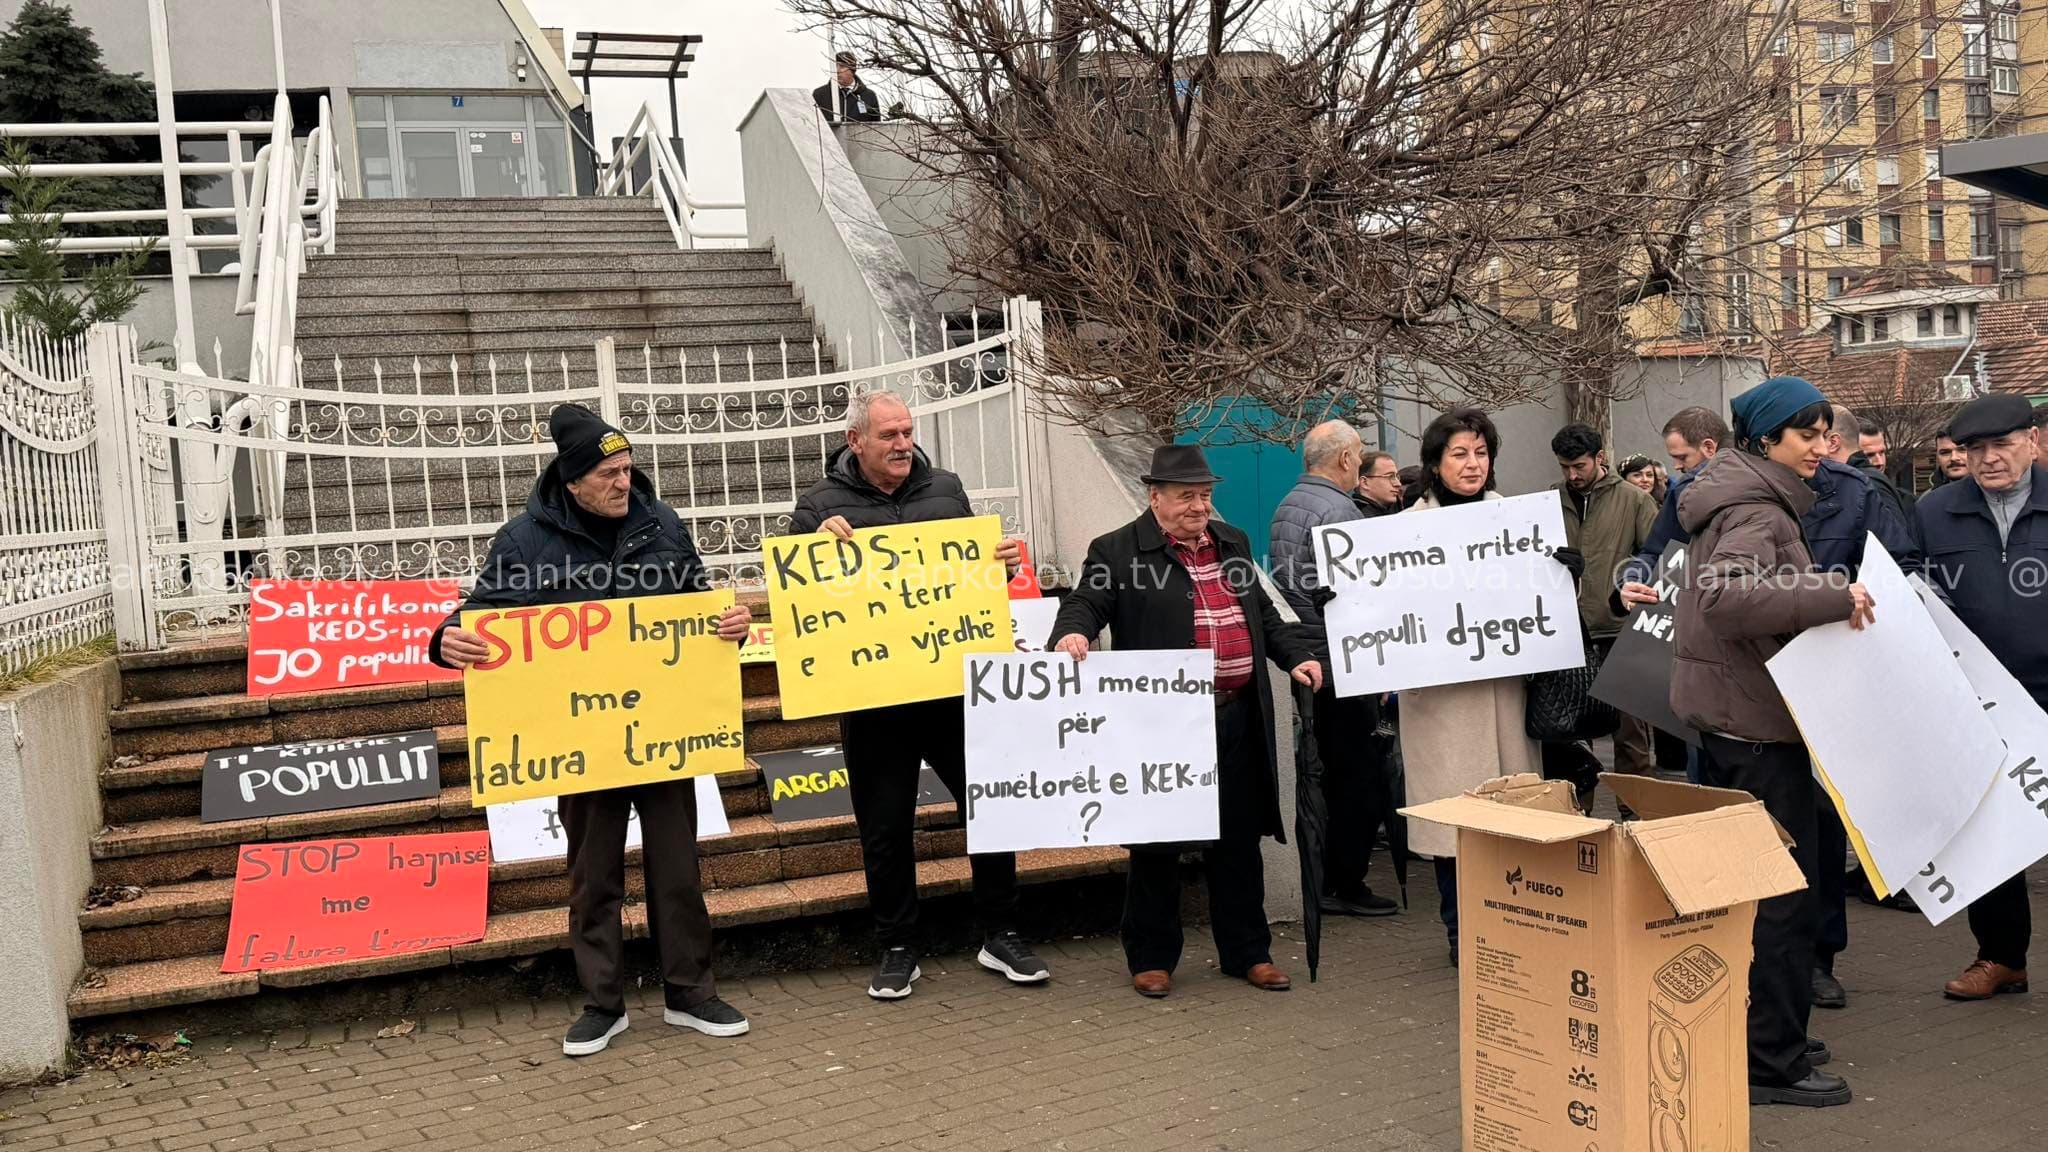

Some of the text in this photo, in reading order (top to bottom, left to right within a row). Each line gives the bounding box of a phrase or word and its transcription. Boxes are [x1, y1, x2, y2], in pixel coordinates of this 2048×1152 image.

[454, 96, 461, 107] 7
[772, 534, 980, 590] KEDS-i na
[1321, 528, 1446, 587] Rryma
[473, 601, 732, 671] STOP hajnis
[791, 603, 846, 639] len
[1341, 595, 1557, 674] populli djeget
[800, 656, 815, 677] e
[851, 642, 890, 667] na
[911, 609, 995, 663] vjedhë
[254, 647, 323, 685] JO
[971, 659, 1215, 707] KUSH mendon
[570, 689, 642, 717] me
[1058, 712, 1107, 749] për
[239, 745, 434, 803] POPULLIT
[473, 733, 586, 794] fatura
[967, 762, 1217, 821] punëtorët e KEK-ut
[1079, 801, 1101, 843] ?
[242, 842, 487, 888] STOP hajnisë
[321, 896, 370, 915] me
[1526, 880, 1564, 898] FUEGO
[1484, 899, 1588, 929] MULTIFUNCTIONAL BT SPEAKER
[239, 934, 347, 968] fatura
[1476, 936, 1486, 944] EN
[1476, 993, 1486, 1001] AL
[1572, 998, 1595, 1010] WOOFER
[1476, 1050, 1488, 1059] BIH
[1580, 1083, 1598, 1092] LIGHTS
[1474, 1104, 1486, 1113] MK
